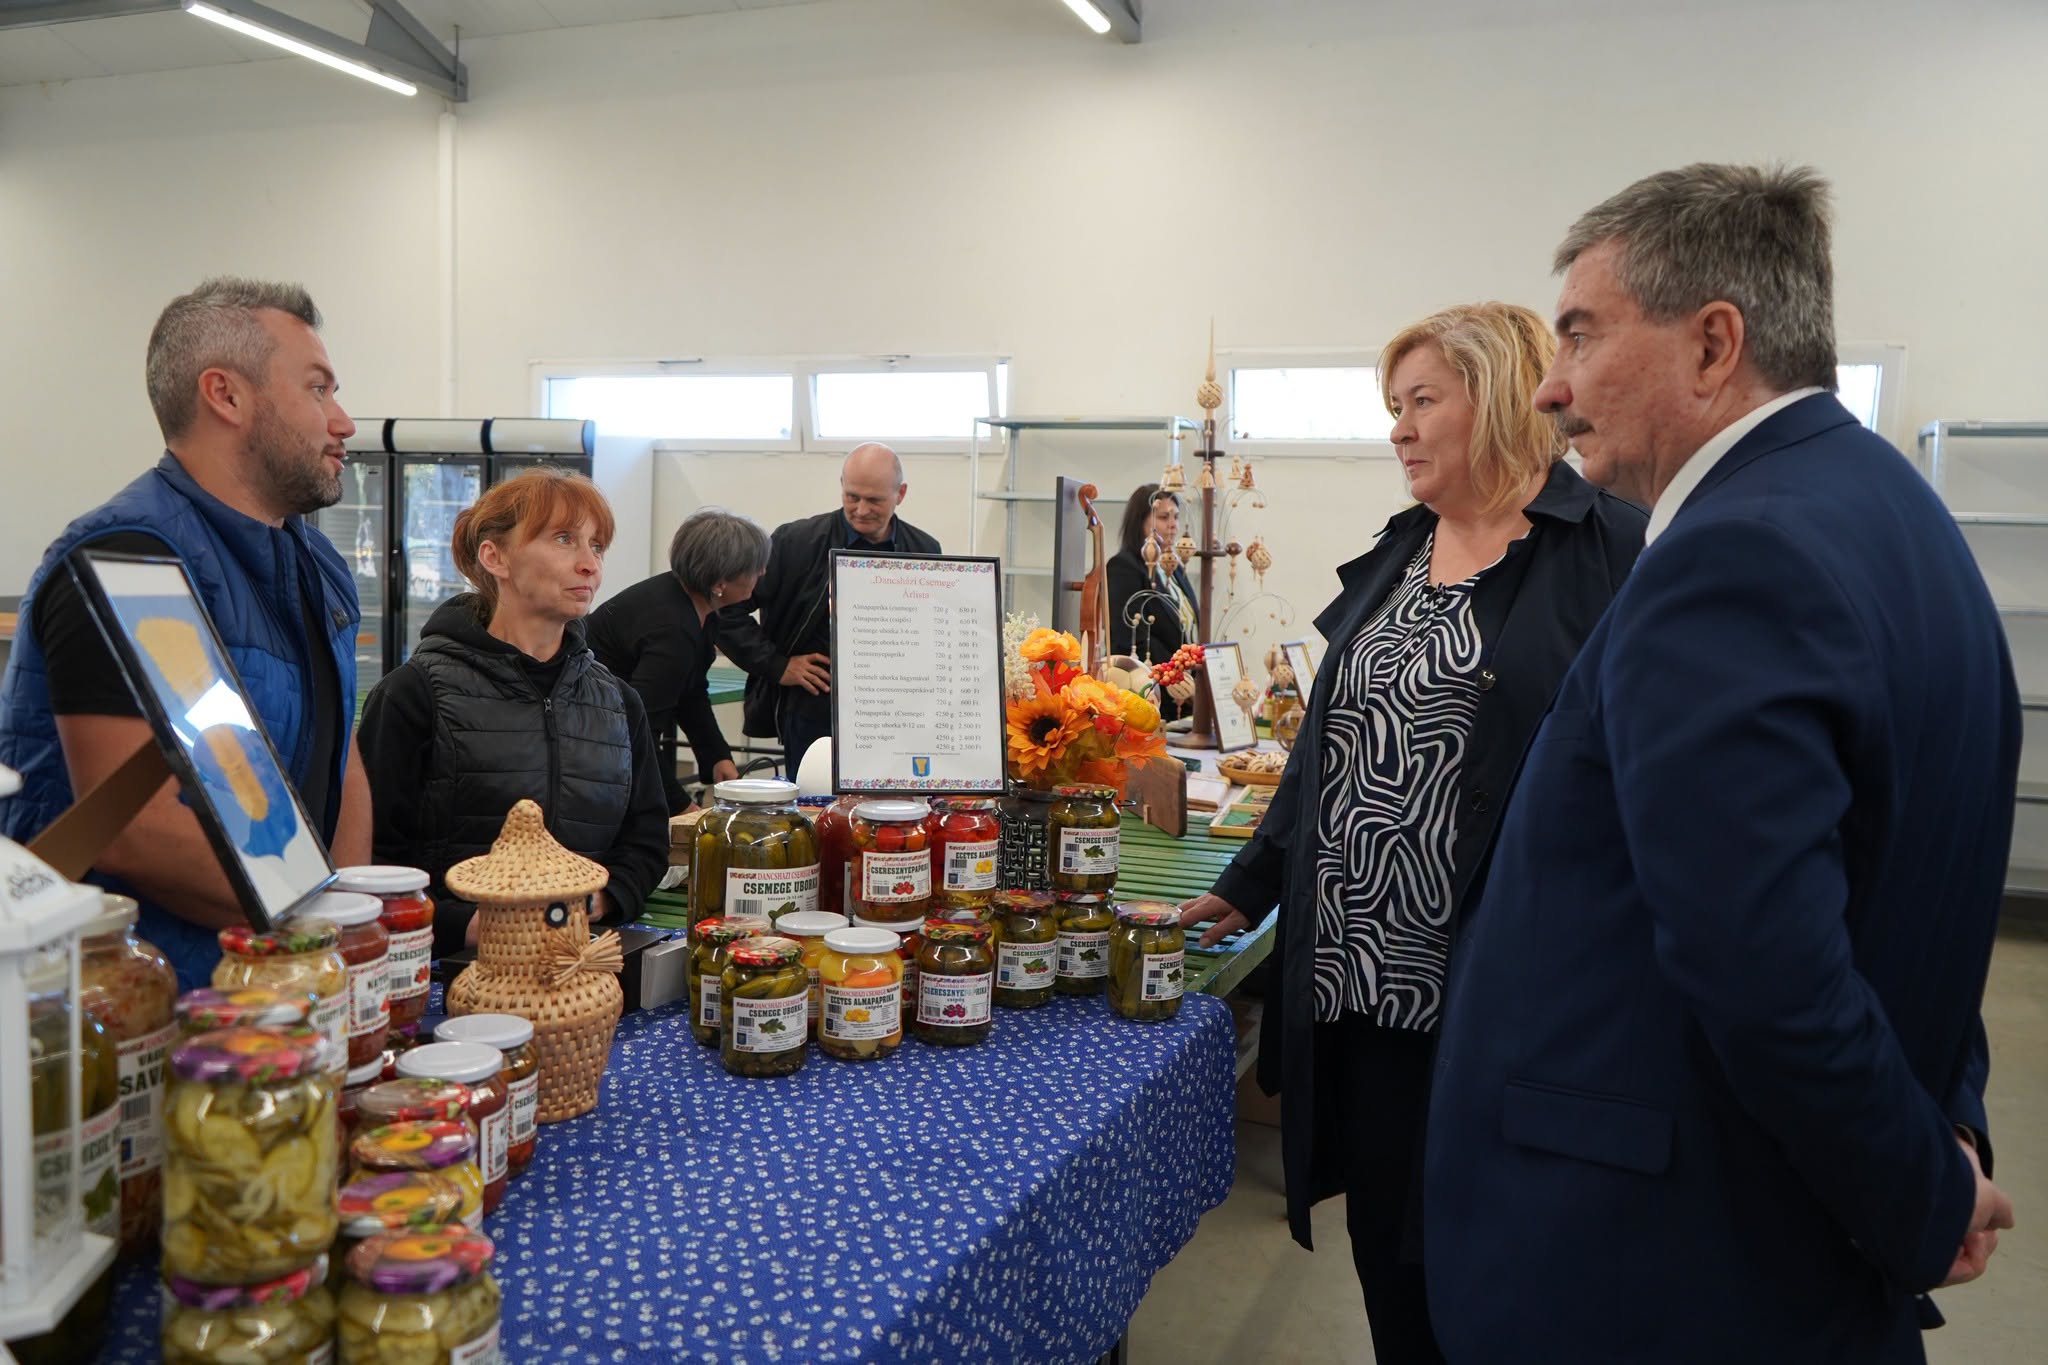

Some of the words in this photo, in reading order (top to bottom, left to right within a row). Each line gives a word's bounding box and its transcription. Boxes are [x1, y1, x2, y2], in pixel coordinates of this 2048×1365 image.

[902, 589, 930, 599] Árlista
[743, 882, 792, 895] CSEMEGE
[830, 996, 852, 1005] ECETES
[854, 994, 894, 1005] ALMAPAPRIKA
[749, 1009, 781, 1017] CSEMEGE
